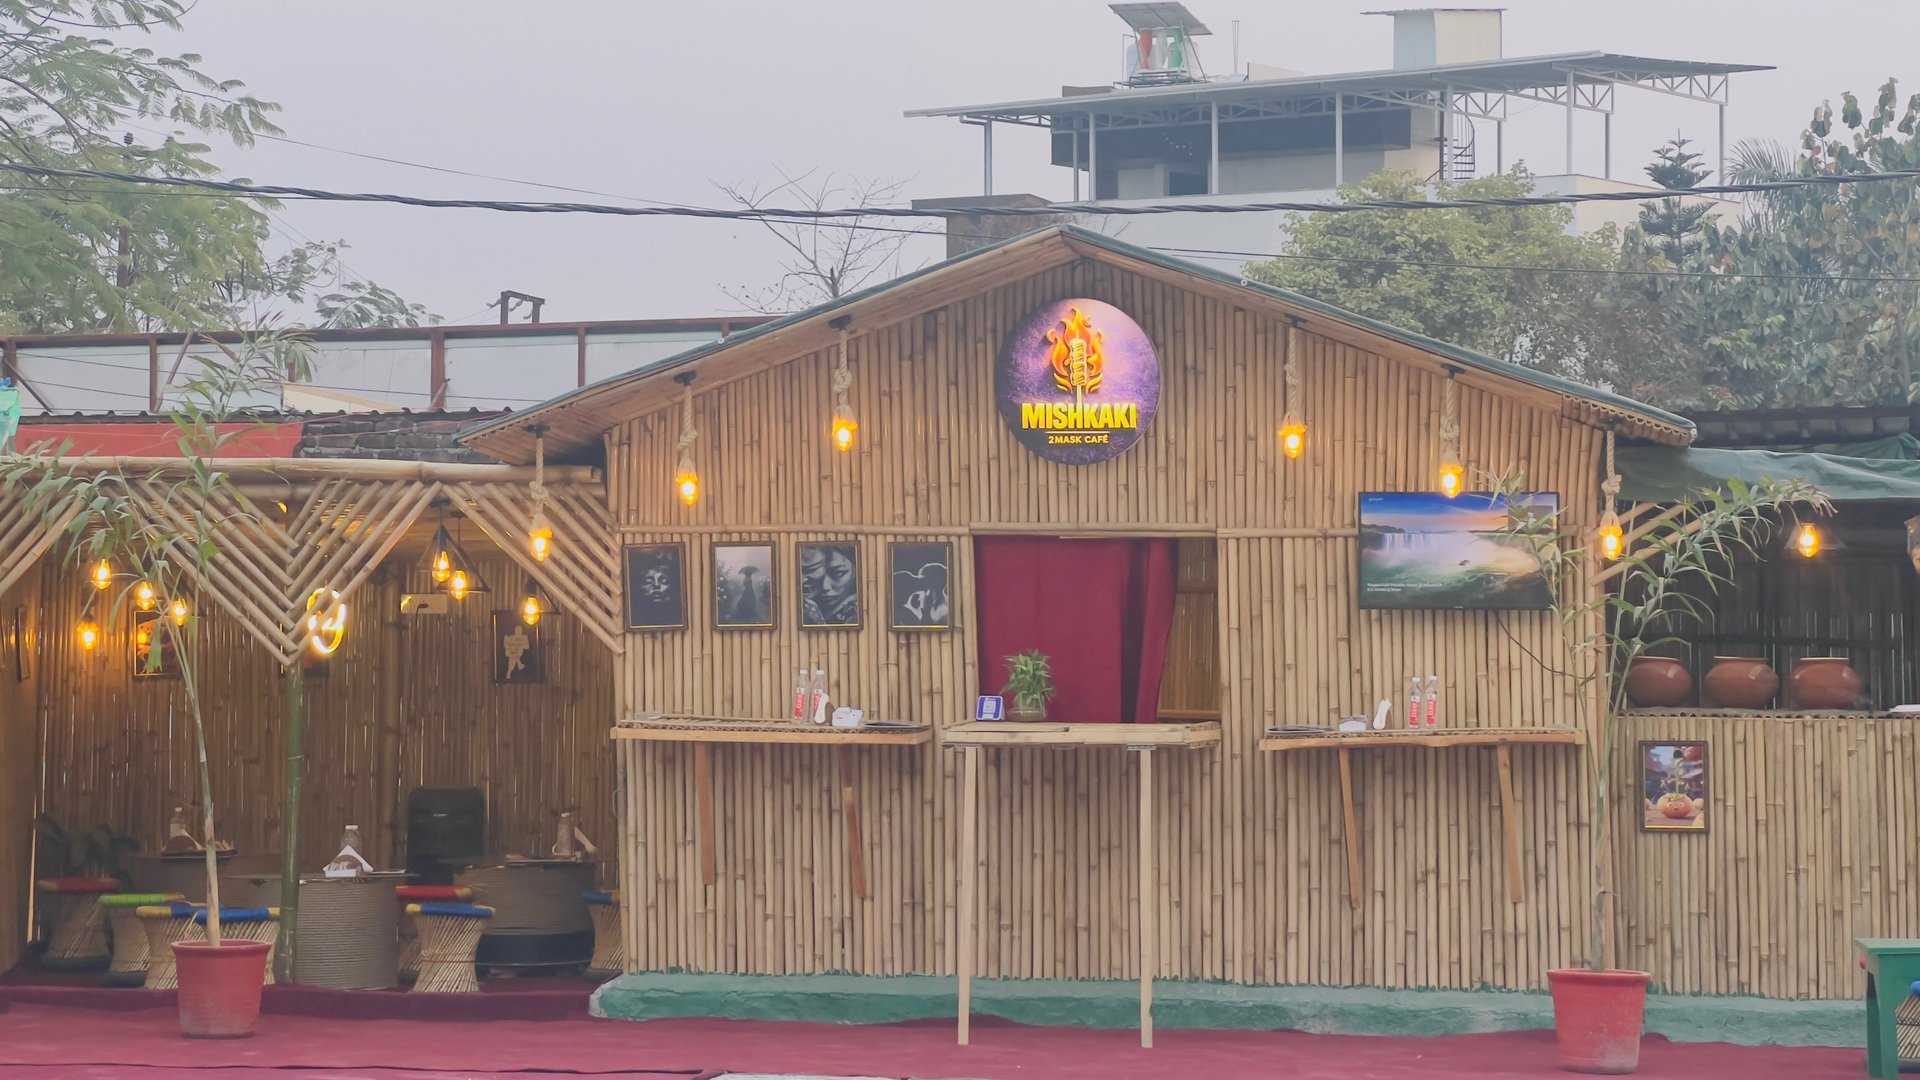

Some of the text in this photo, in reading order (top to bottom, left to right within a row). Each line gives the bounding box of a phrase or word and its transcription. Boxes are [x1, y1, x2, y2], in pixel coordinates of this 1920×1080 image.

[1022, 403, 1137, 429] MISHKAKI
[1048, 434, 1109, 444] 2MASK CAFÉ
